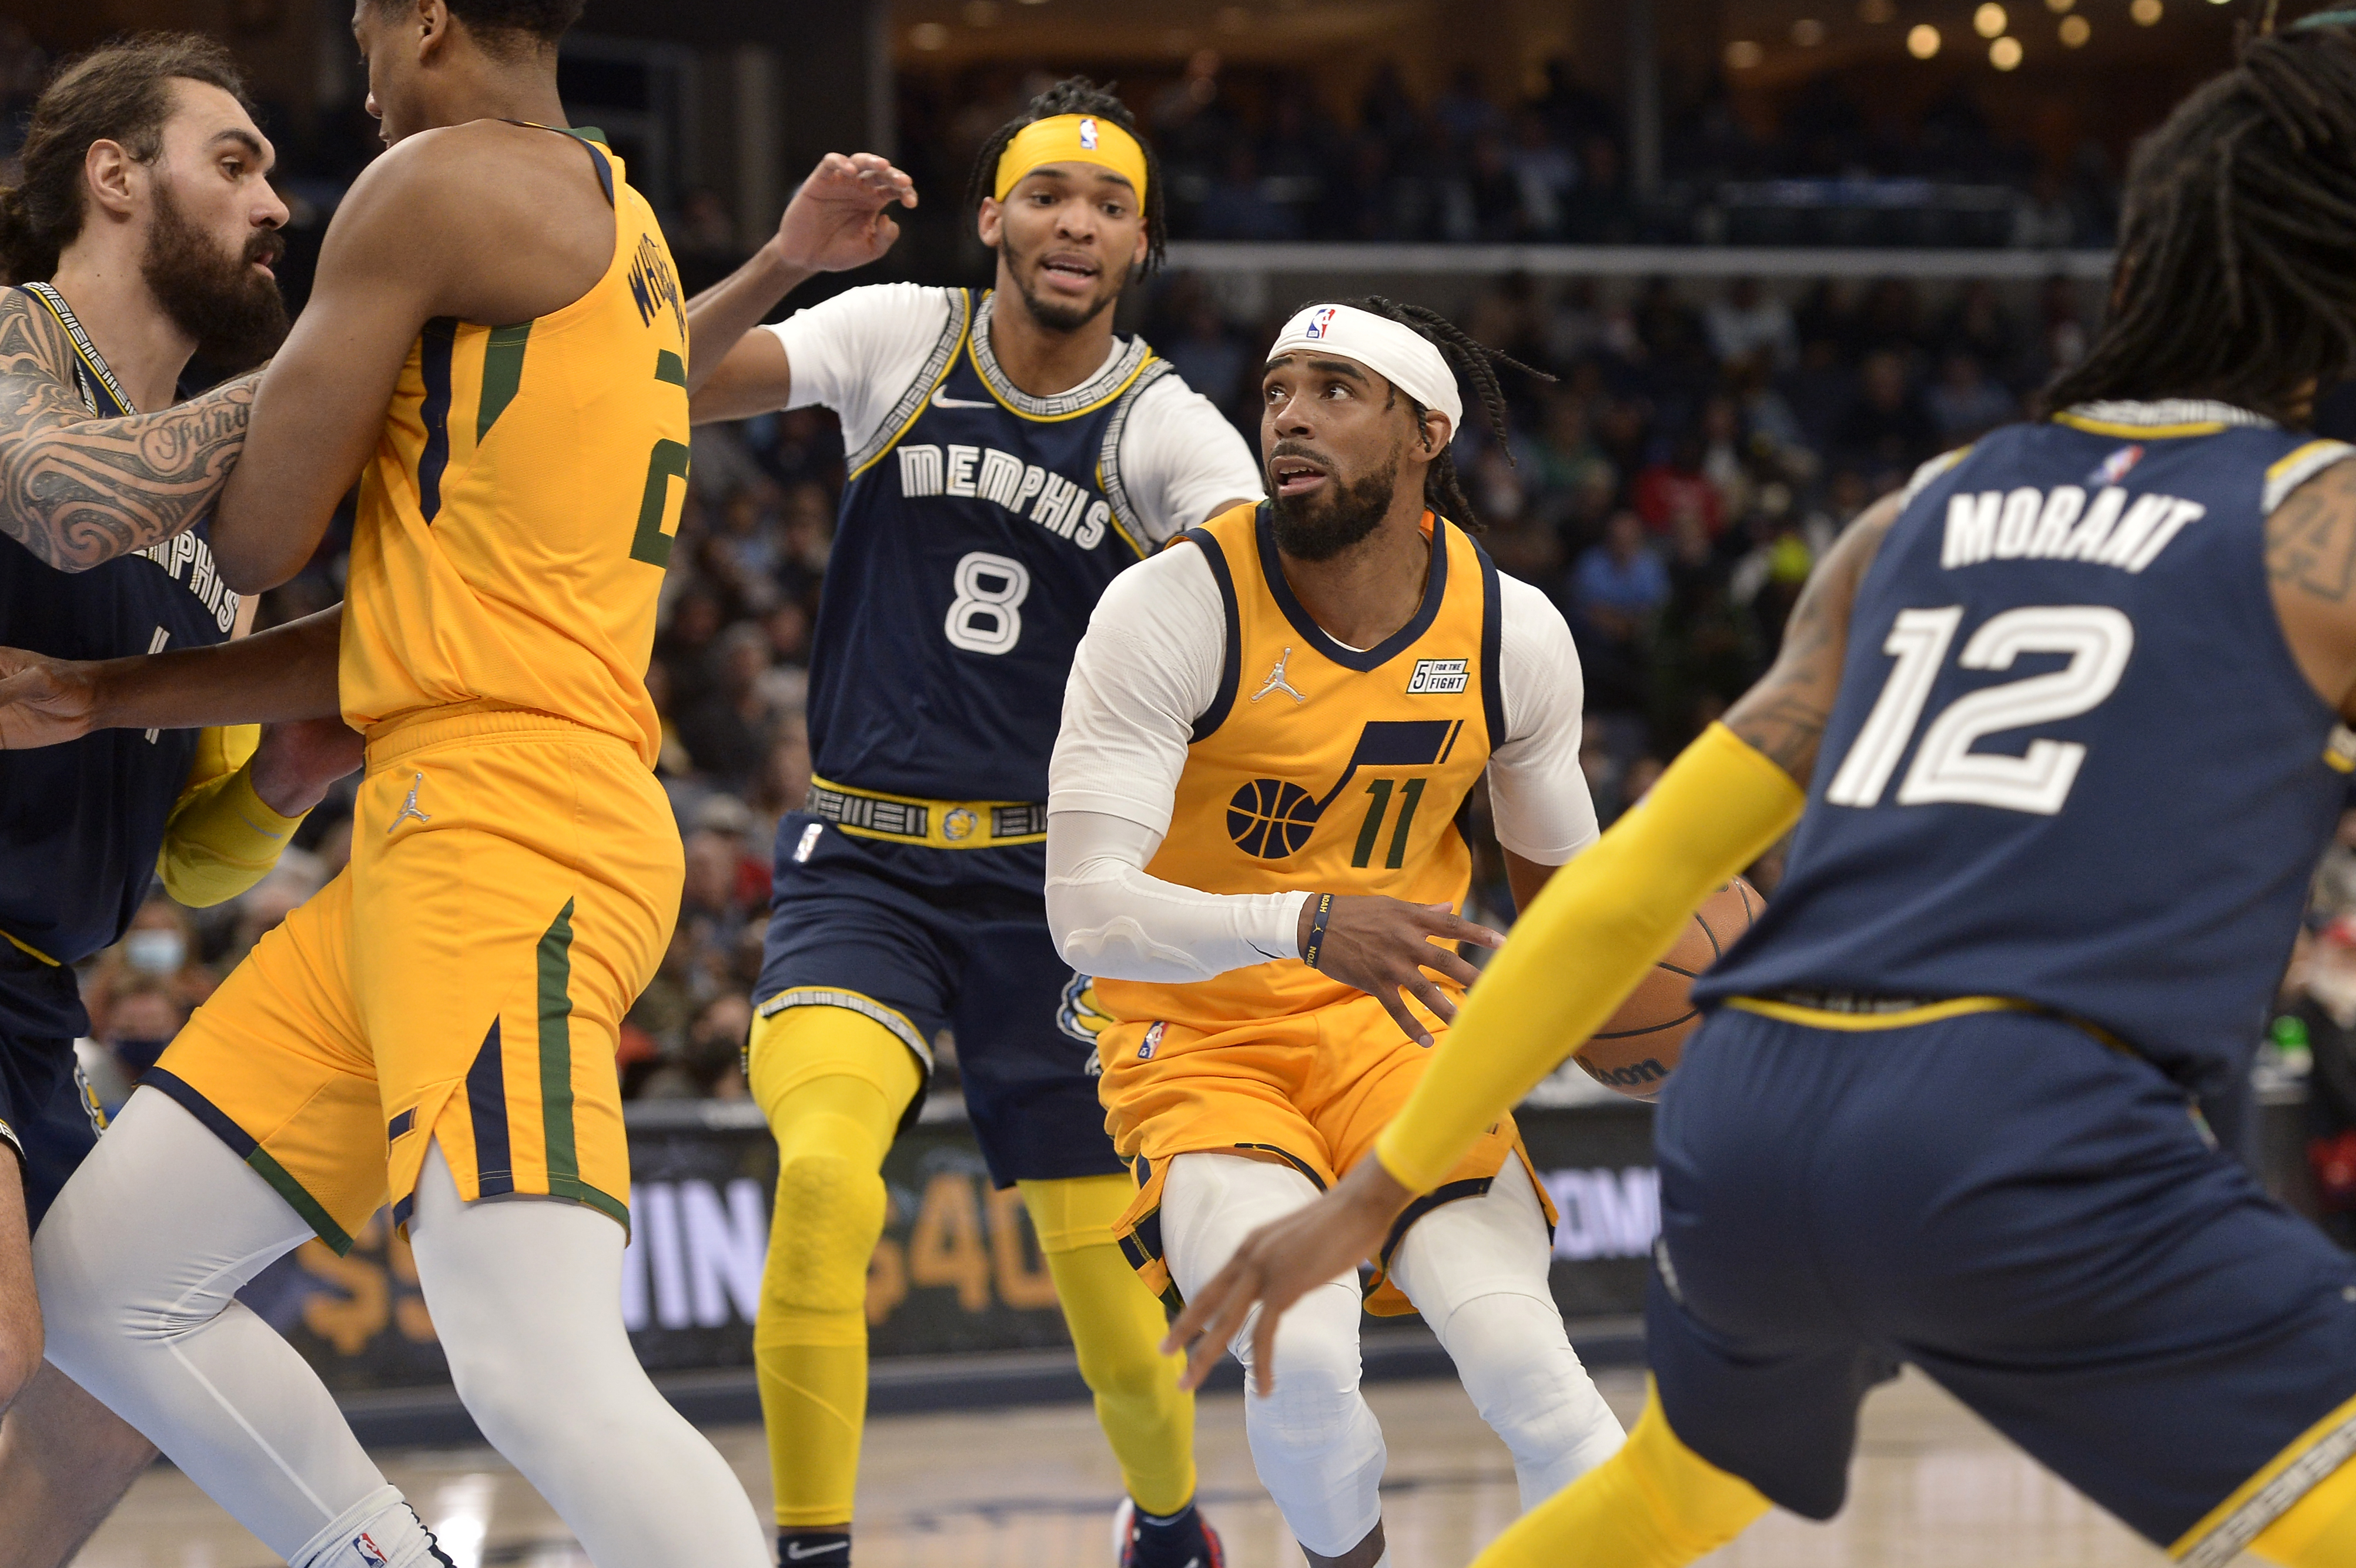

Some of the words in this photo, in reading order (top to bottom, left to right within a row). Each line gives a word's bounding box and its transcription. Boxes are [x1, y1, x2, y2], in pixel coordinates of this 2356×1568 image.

[896, 444, 1111, 551] MEMPHIS
[1941, 484, 2206, 574] MORANT
[944, 551, 1030, 655] 8
[1413, 664, 1430, 689] 5
[1429, 677, 1463, 689] FIGHT
[1825, 604, 2135, 816] 12
[1350, 778, 1427, 869] 11
[1319, 894, 1331, 913] NOAH
